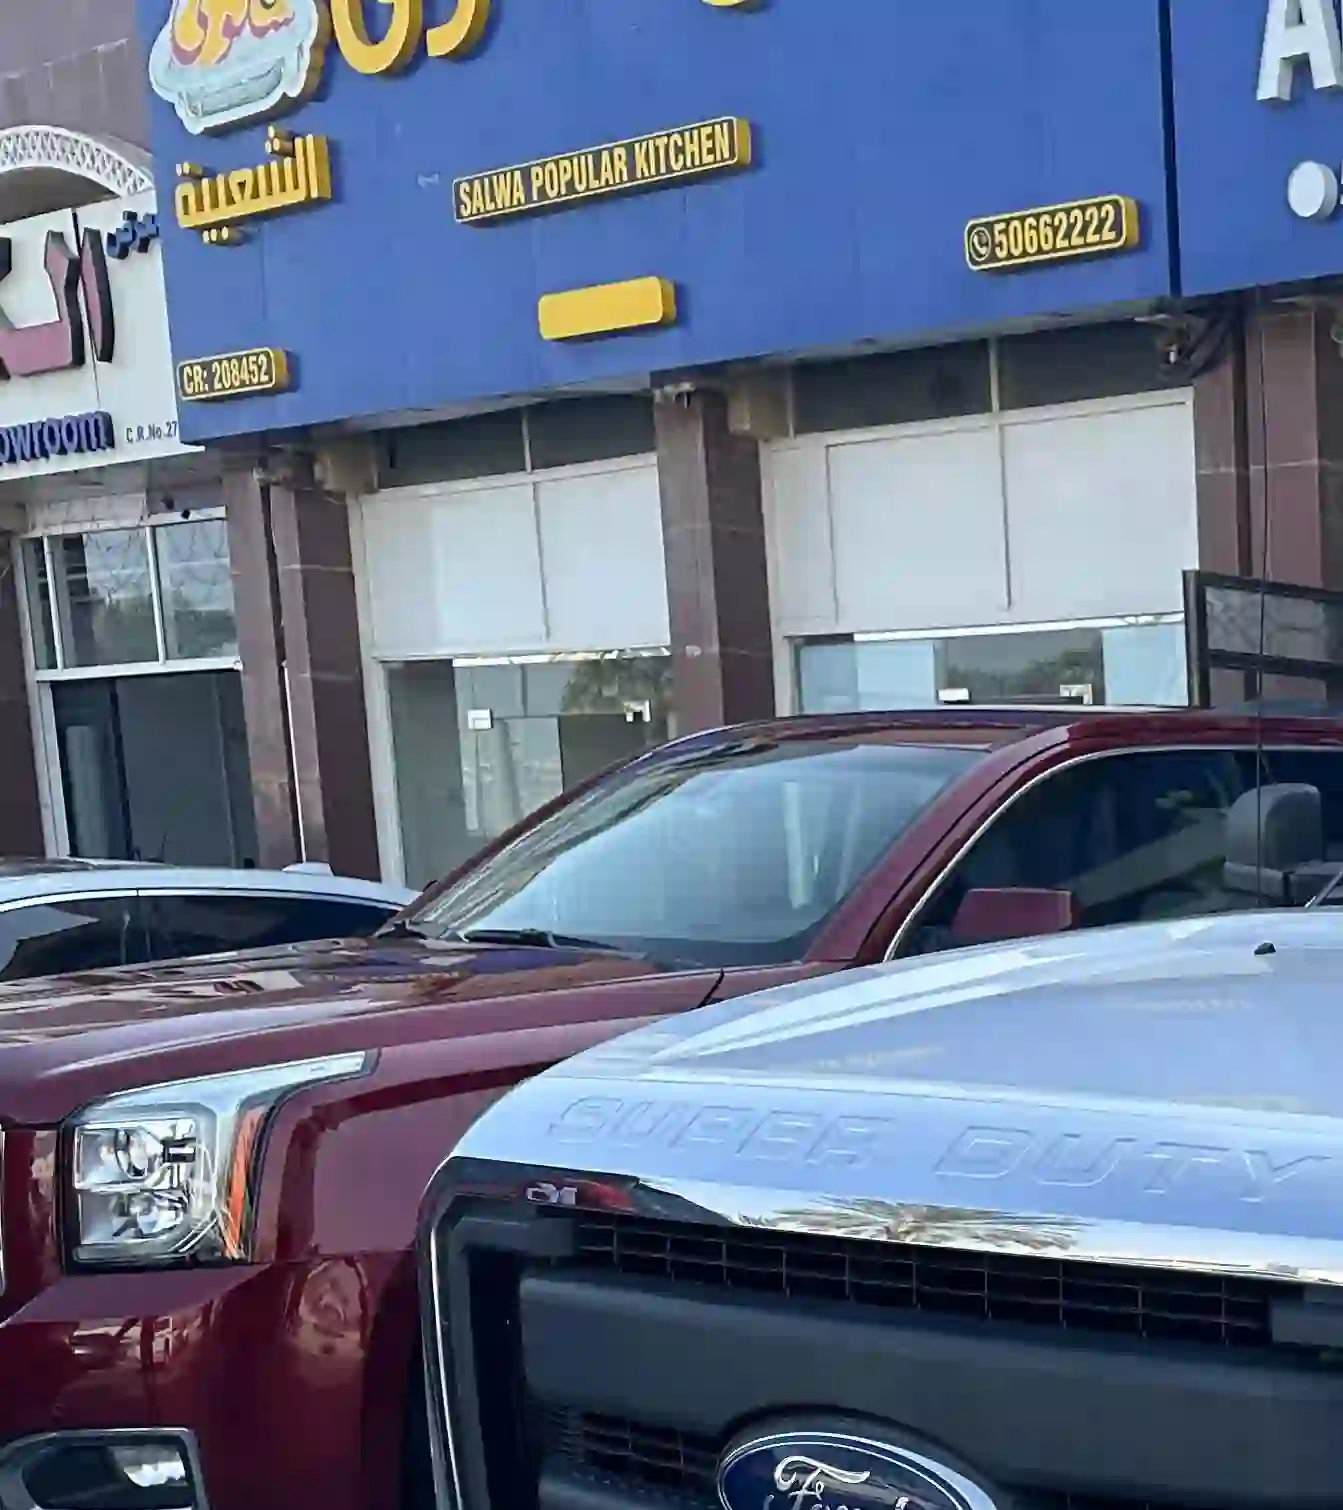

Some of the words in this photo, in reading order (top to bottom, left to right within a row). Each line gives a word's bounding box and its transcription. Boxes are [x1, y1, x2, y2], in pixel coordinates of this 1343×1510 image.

[174, 125, 327, 243] الشعبية
[459, 169, 526, 217] SALWA
[531, 146, 629, 201] POPULAR
[634, 121, 730, 179] KITCHEN
[993, 203, 1117, 259] 50662222
[183, 365, 209, 394] CR:
[211, 353, 269, 390] 208452
[547, 1093, 896, 1170] SUPER
[934, 1123, 1335, 1203] DUTY
